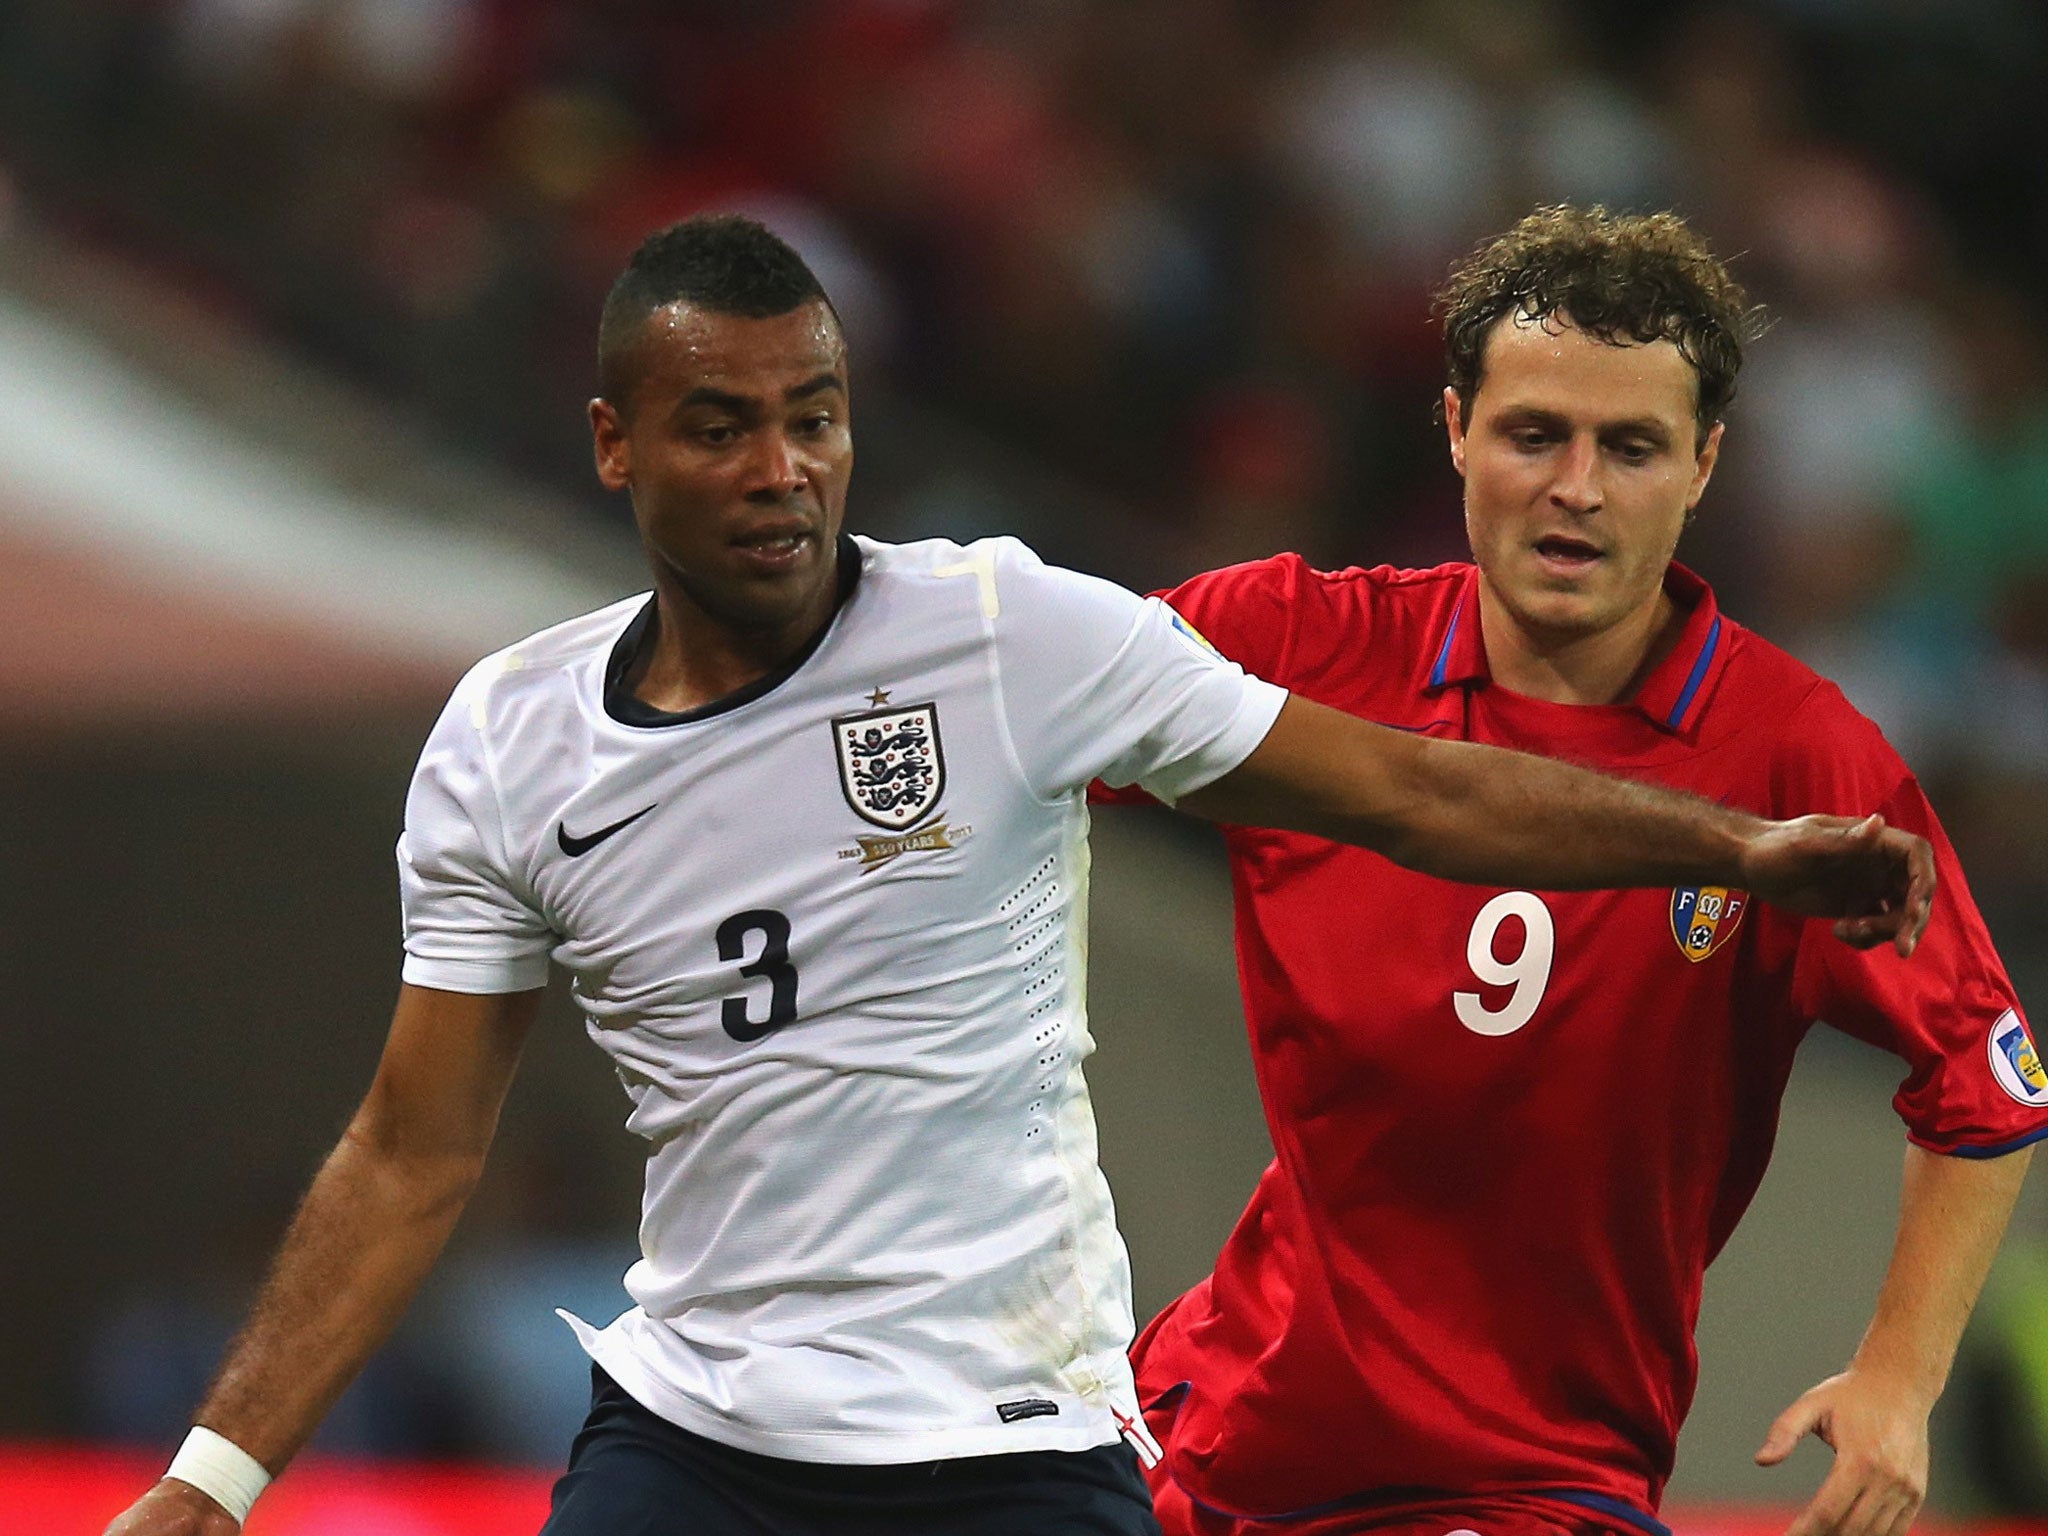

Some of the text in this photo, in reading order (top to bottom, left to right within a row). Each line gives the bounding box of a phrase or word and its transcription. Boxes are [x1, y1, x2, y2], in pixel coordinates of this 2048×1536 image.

[896, 834, 935, 851] YEARS
[1677, 891, 1695, 910] F
[1725, 900, 1741, 919] F
[715, 909, 798, 1042] 3
[1453, 890, 1555, 1037] 9
